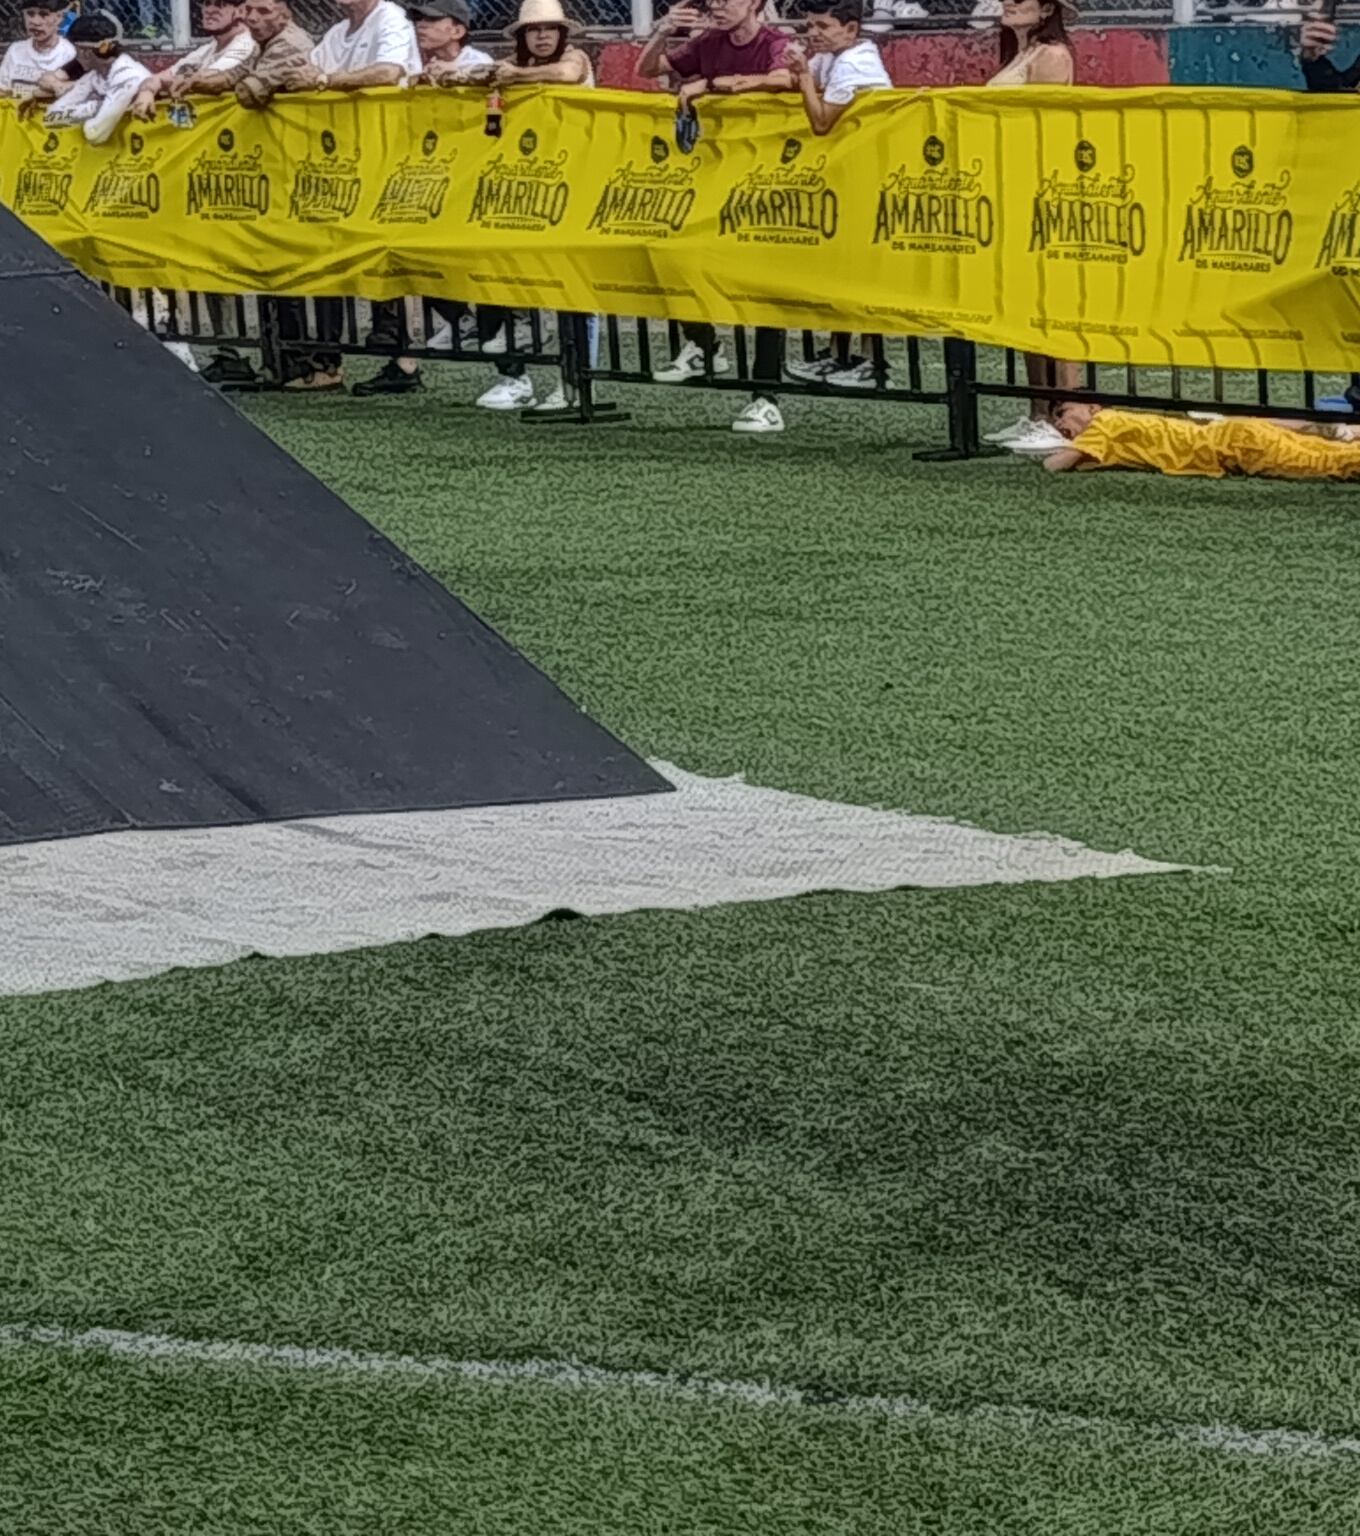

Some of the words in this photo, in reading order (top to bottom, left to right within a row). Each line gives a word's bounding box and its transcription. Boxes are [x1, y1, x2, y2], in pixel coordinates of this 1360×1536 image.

[186, 171, 270, 216] AMARILLO
[467, 175, 570, 227] AMARILLO
[586, 183, 696, 231] AMARILLO
[719, 186, 839, 240] AMARILLO
[872, 190, 994, 248] AMARILLO
[1027, 196, 1146, 257] AMARILLO
[1177, 204, 1293, 266] AMARILLO
